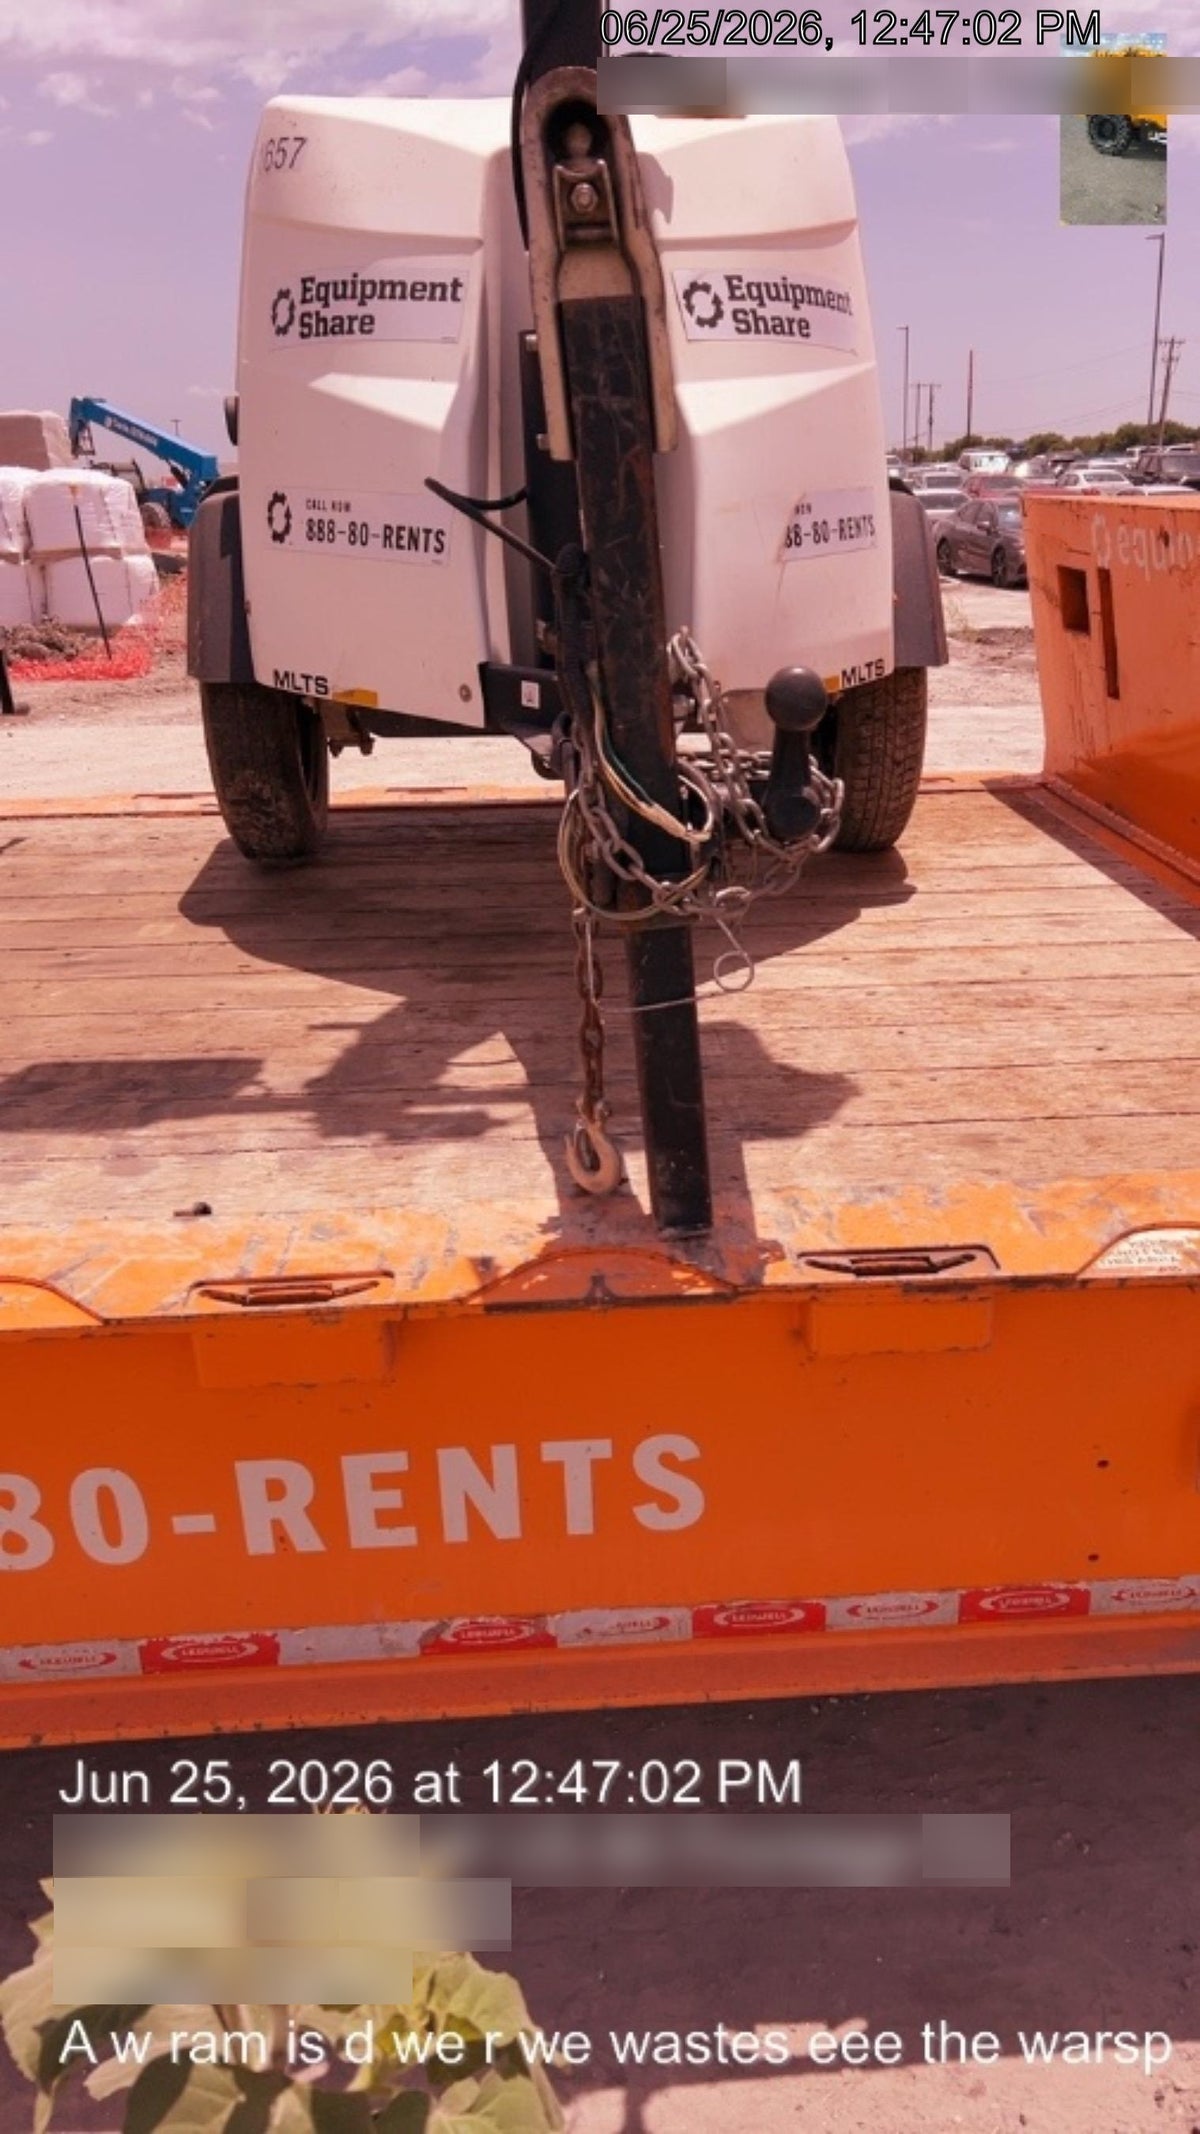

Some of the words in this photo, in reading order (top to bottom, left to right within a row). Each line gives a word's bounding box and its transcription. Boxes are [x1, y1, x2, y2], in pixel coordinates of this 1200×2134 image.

[262, 136, 307, 171] 657
[299, 273, 463, 308] Equipment
[724, 275, 853, 316] Equipment
[299, 310, 376, 339] Share
[732, 308, 812, 338] Share
[305, 517, 446, 554] 888-80-RENTS
[272, 669, 329, 695] MLTS
[841, 658, 886, 688] MLTS
